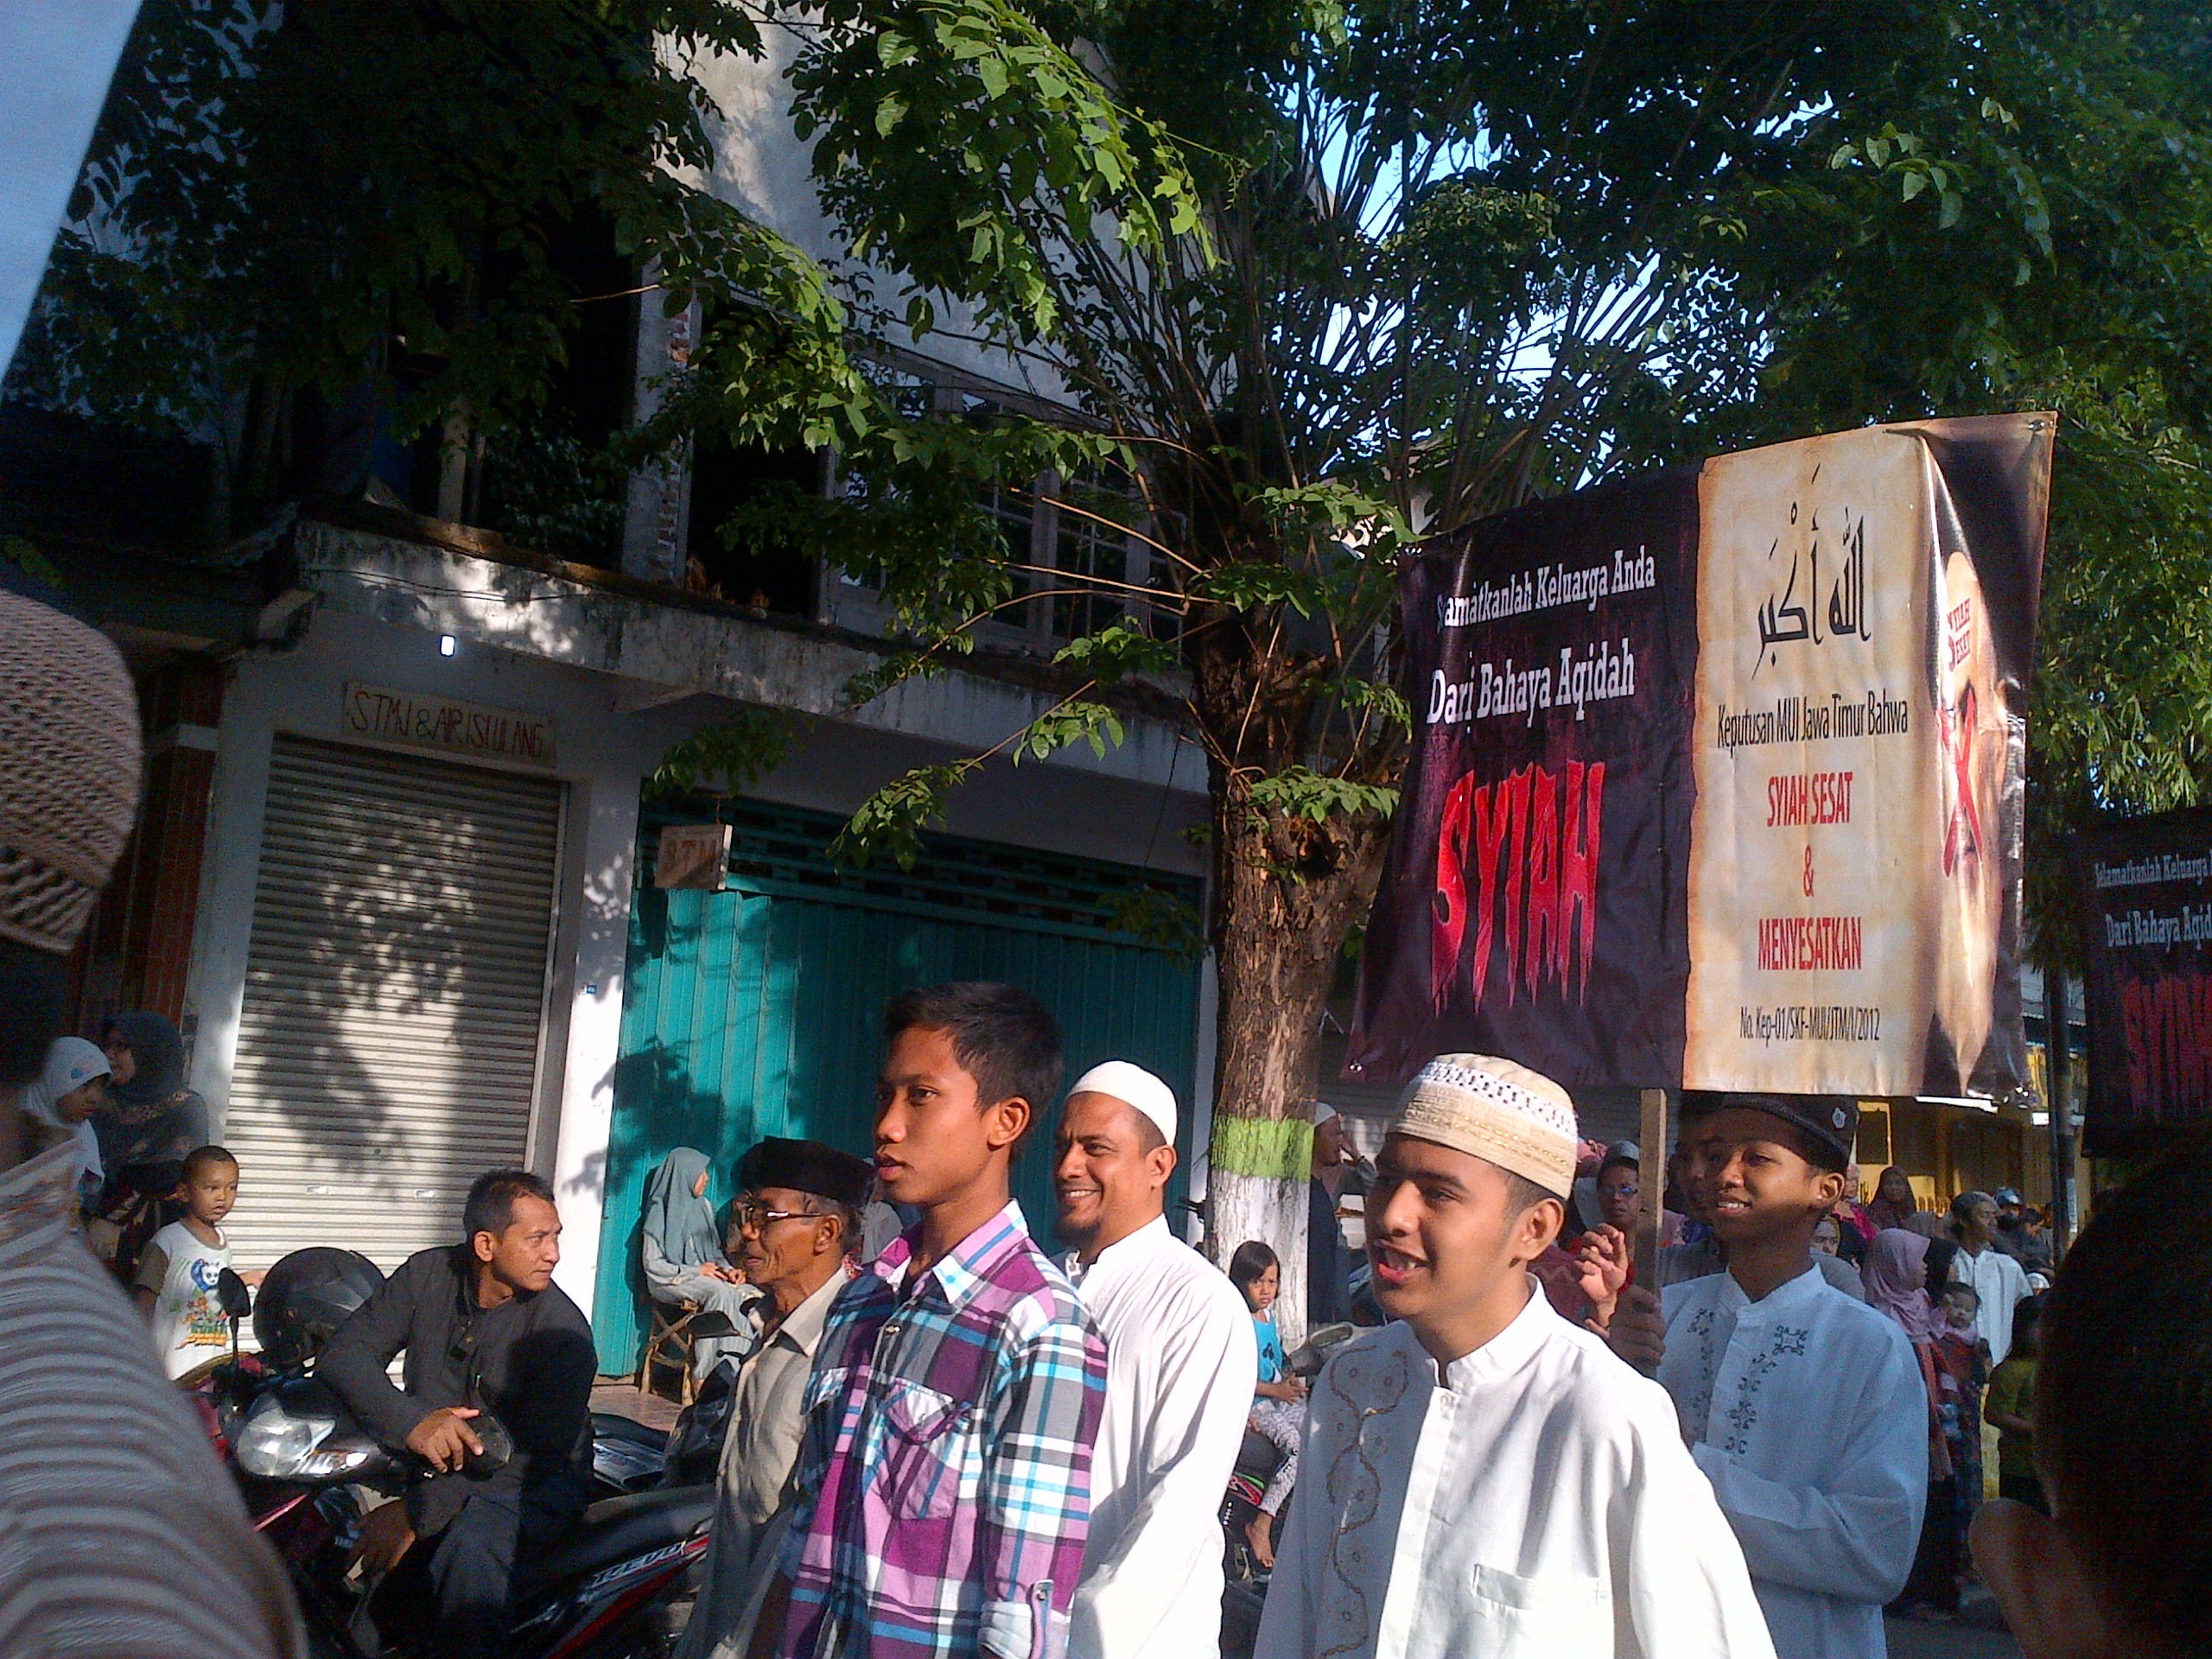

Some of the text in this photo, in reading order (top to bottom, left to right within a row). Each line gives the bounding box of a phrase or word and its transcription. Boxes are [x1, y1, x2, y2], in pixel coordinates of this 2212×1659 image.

[1535, 563, 1608, 611] Keluarga
[1611, 545, 1656, 594] Anda
[1427, 637, 1635, 728] Dari Bahaya Aqidah
[416, 709, 432, 738] &
[1718, 689, 1909, 759] Keputusan MUI Jawa Timur Bahwa
[1767, 772, 1853, 827] SYIAH SESAT
[1432, 761, 1606, 1018] SYIAH
[1802, 844, 1814, 897] &
[2163, 854, 2209, 886] Keluarga
[1758, 917, 1862, 970] MENYESATKAN
[2106, 911, 2133, 947] Dari
[2133, 909, 2180, 952] Bahaya
